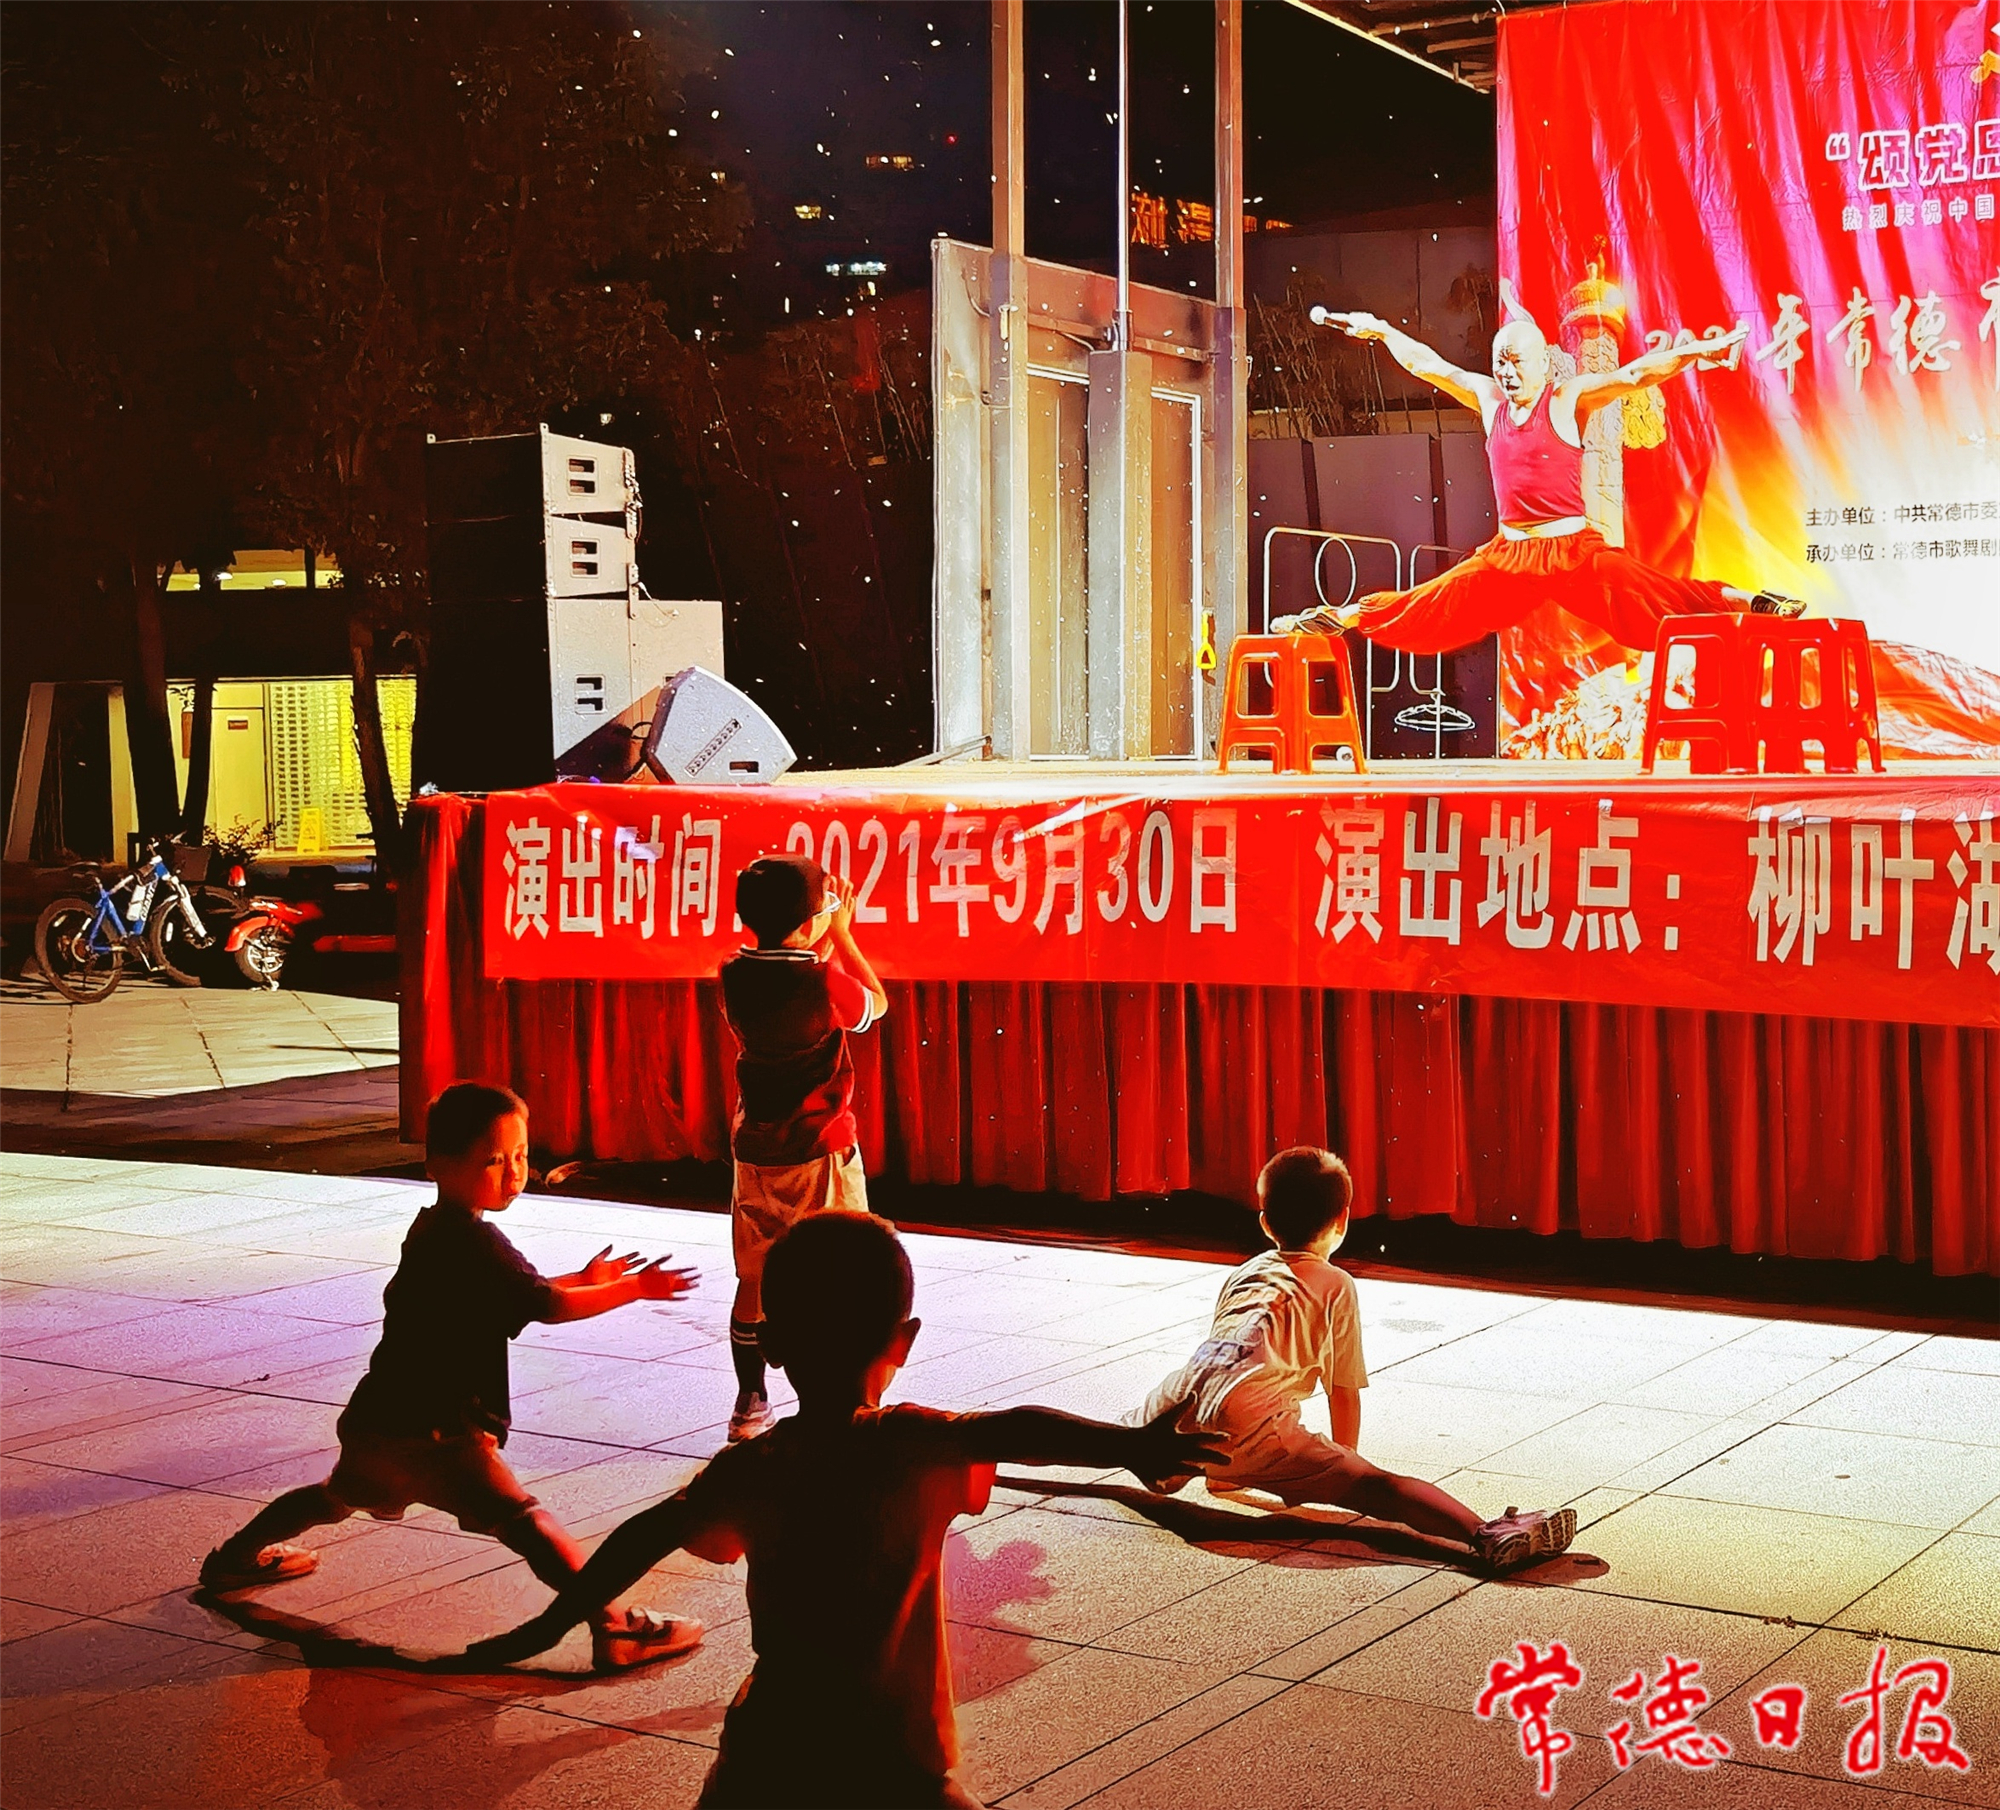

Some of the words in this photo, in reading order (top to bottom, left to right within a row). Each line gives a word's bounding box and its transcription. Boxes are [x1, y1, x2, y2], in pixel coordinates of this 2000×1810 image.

[1842, 194, 1996, 231] 热烈庆祝中国
[1805, 500, 2000, 526] 主办单位：中共常德市委
[503, 801, 1237, 939] 演出时间021年9月30日
